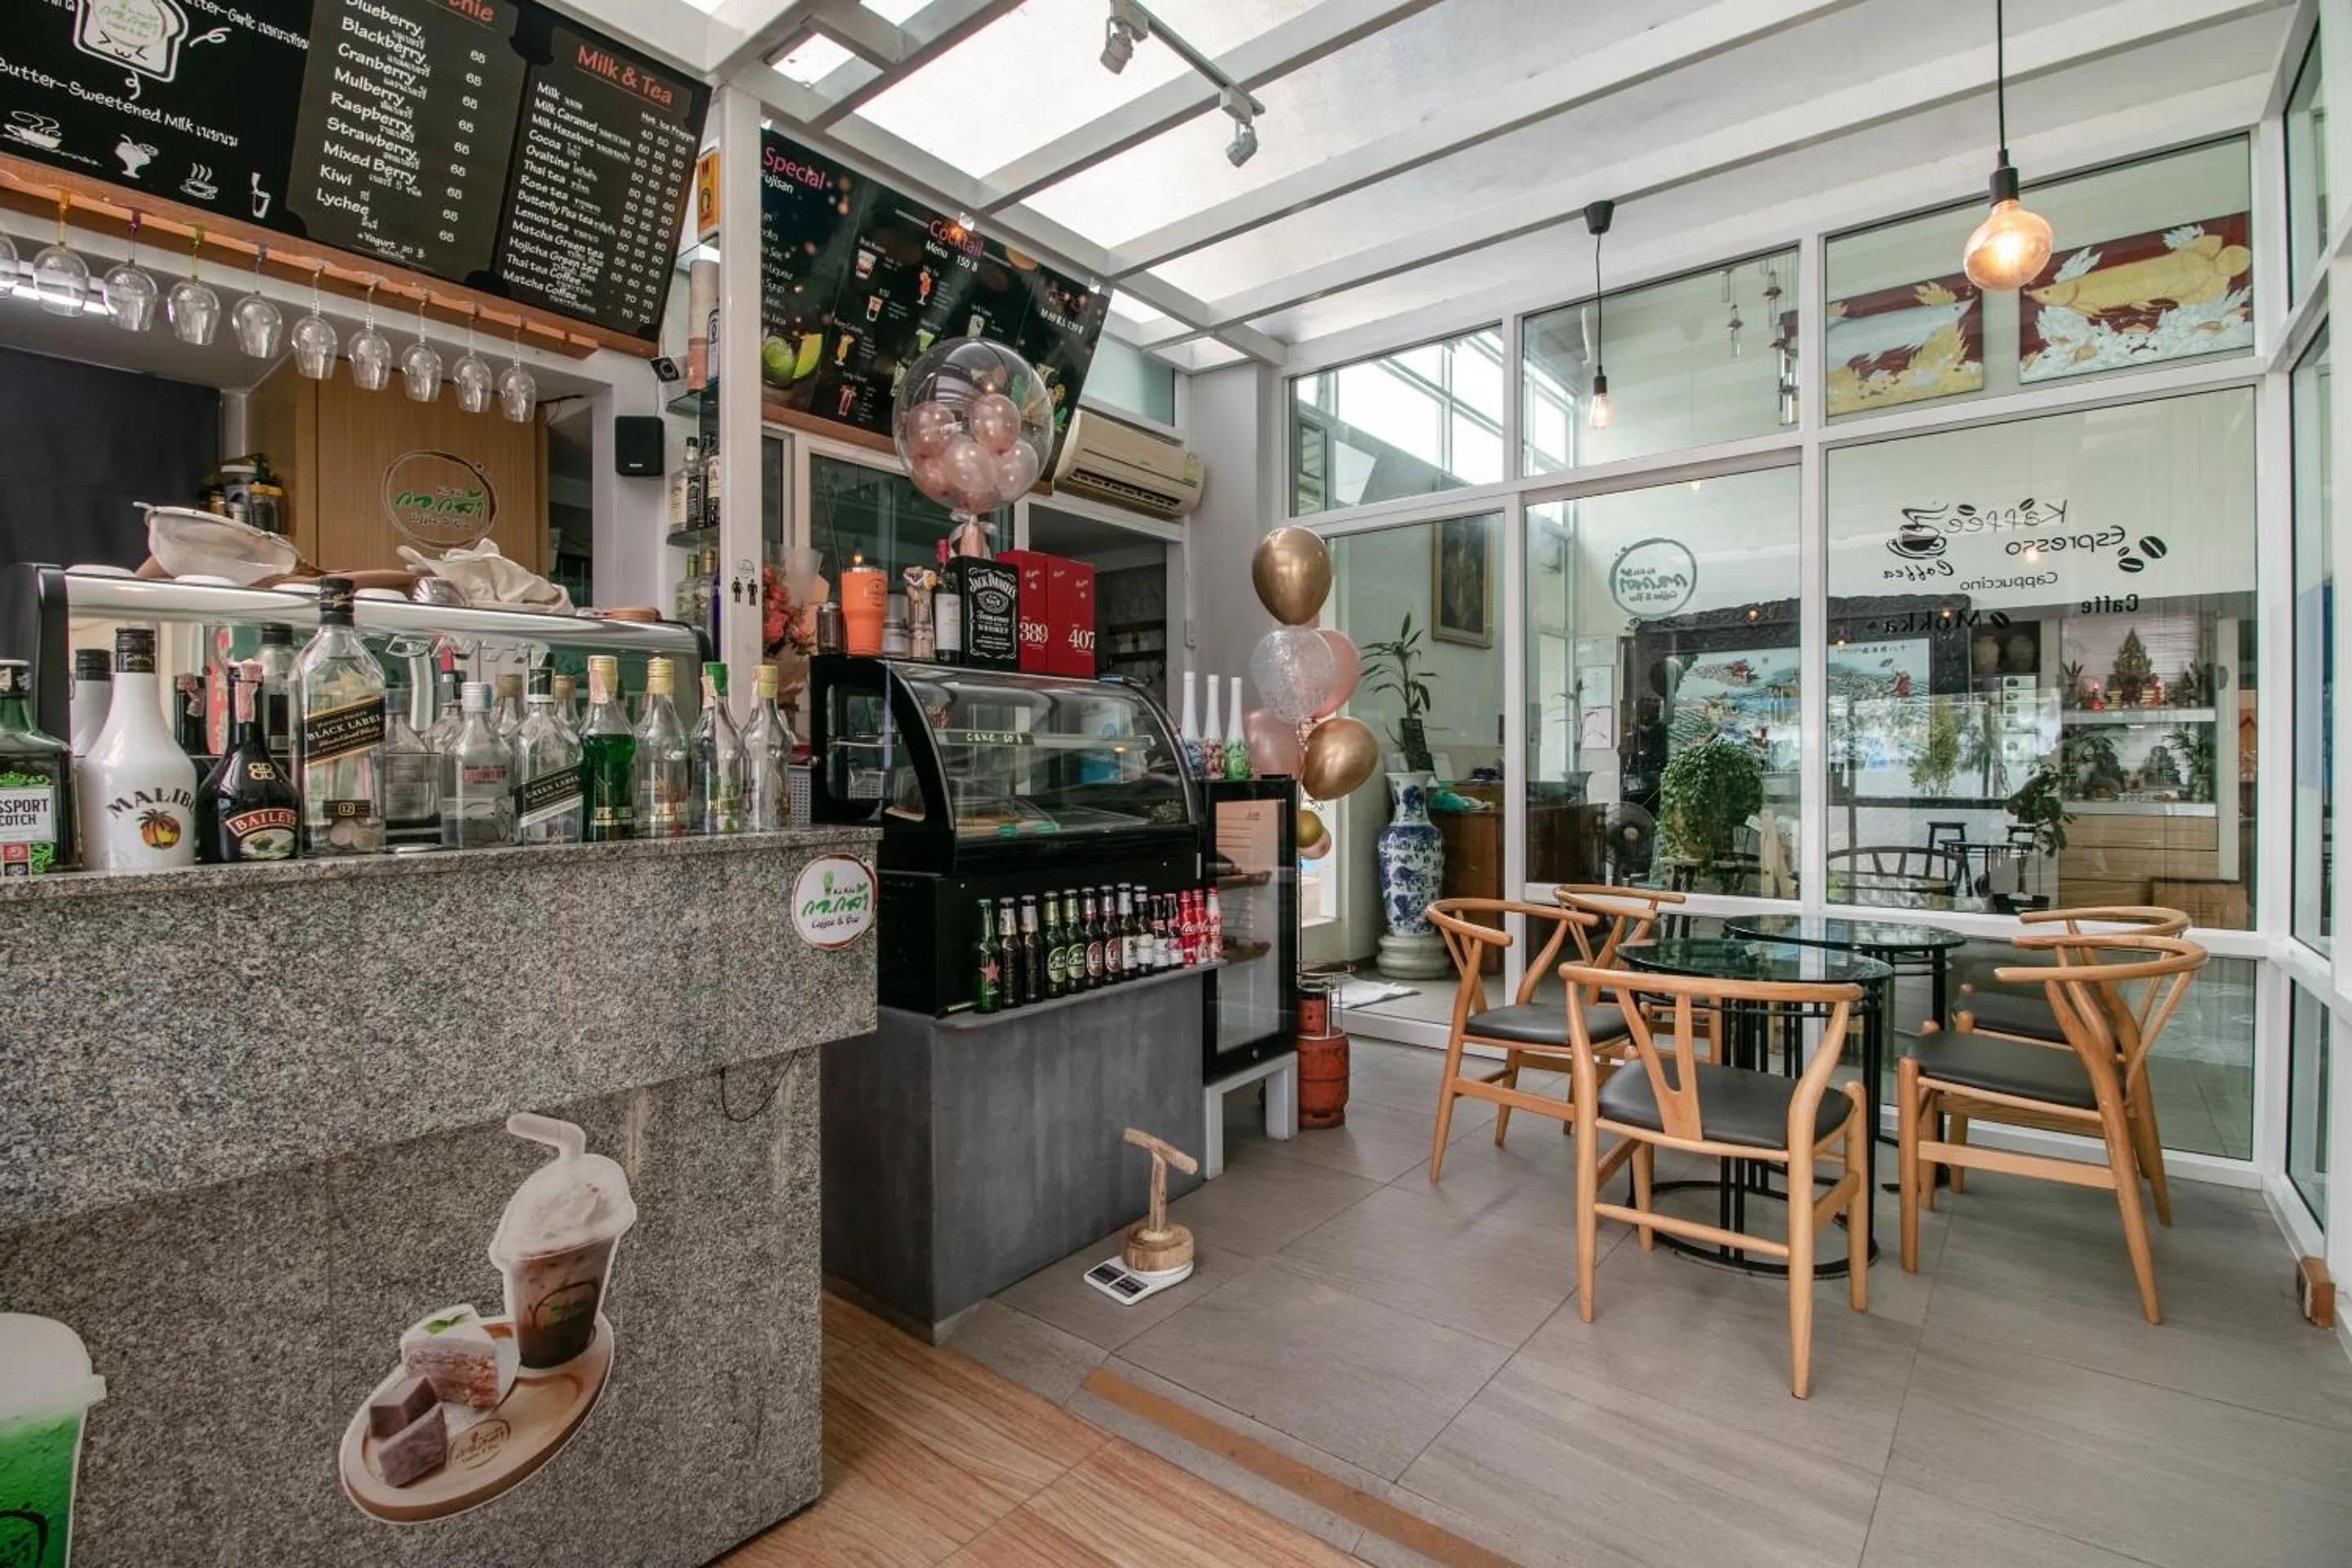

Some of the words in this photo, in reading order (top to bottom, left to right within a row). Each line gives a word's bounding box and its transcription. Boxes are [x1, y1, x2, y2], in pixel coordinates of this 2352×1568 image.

[345, 0, 422, 37] Blueberry
[341, 16, 426, 65] Blackberry
[338, 43, 416, 86] Cranberry
[577, 45, 619, 80] Milk
[621, 67, 638, 88] &
[642, 75, 673, 104] Tea
[334, 66, 405, 107] Mulberry
[537, 81, 560, 100] Milk
[330, 91, 412, 135] Raspberry
[534, 96, 556, 115] Milk
[164, 114, 194, 133] Milk
[532, 113, 552, 130] Milk
[327, 117, 417, 161] Strawberry
[529, 129, 561, 150] Cocoa
[323, 140, 371, 169] Mixed
[373, 158, 416, 185] Berry
[526, 145, 570, 170] Ovaltine
[764, 146, 826, 190] Special
[319, 164, 352, 186] Kiwi
[520, 174, 548, 194] Rose
[550, 187, 568, 201] tea
[547, 170, 566, 185] tea
[316, 188, 370, 216] Lychee
[518, 189, 560, 215] Butterfly
[578, 213, 594, 225] tea
[515, 204, 550, 225] Lemon
[551, 219, 569, 233] tea
[512, 219, 553, 242] Matcha
[555, 234, 586, 253] Green
[587, 246, 604, 260] tea
[506, 253, 529, 269] Thai
[530, 262, 548, 275] tea
[549, 268, 581, 286] Coffee
[550, 251, 580, 269] Green
[581, 262, 599, 275] tea
[503, 269, 544, 291] Matcha
[545, 283, 577, 301] Coffee
[1019, 621, 1048, 644] 389
[1067, 628, 1095, 649] 407
[306, 724, 345, 742] BLACK
[341, 804, 353, 813] 12
